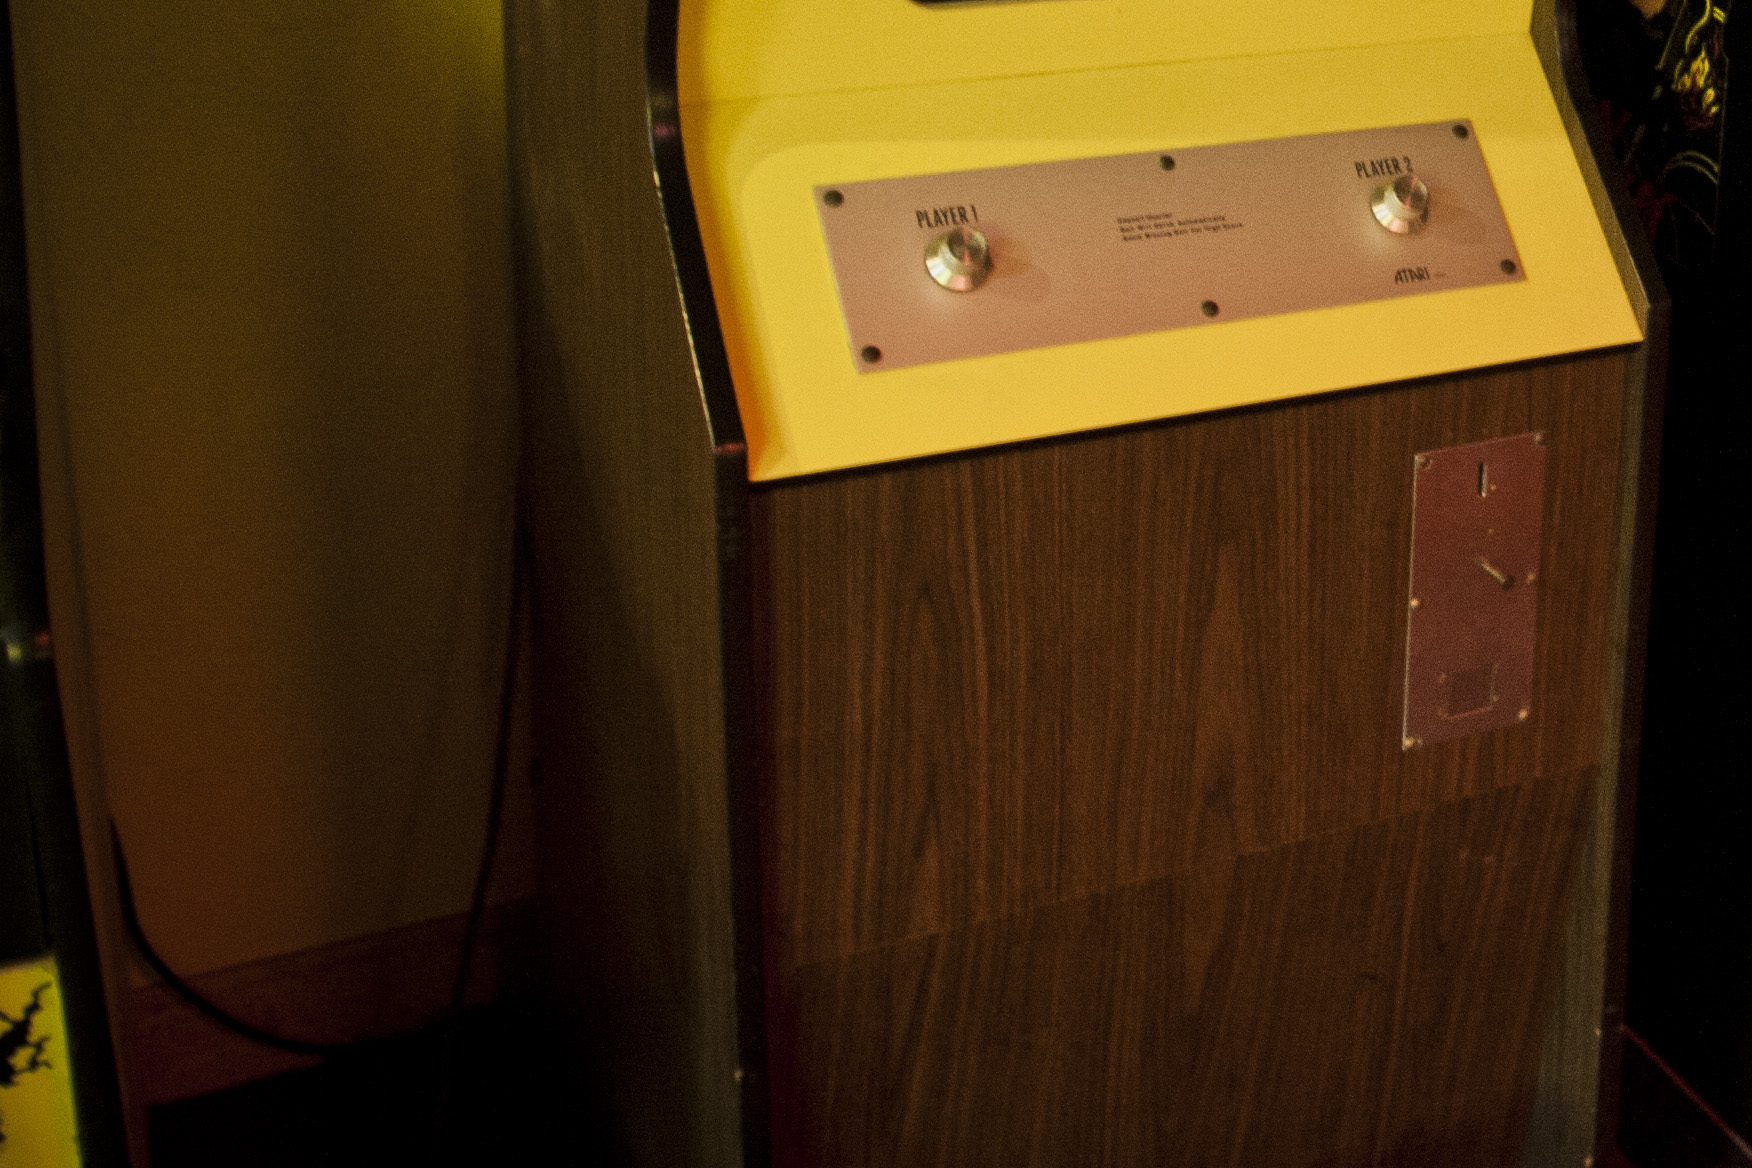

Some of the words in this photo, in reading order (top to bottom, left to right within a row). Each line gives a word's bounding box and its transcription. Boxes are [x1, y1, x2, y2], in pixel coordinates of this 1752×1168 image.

[1354, 157, 1402, 179] PLAYER
[1402, 155, 1414, 173] 2
[915, 205, 969, 229] PLAYER
[970, 205, 979, 223] 1
